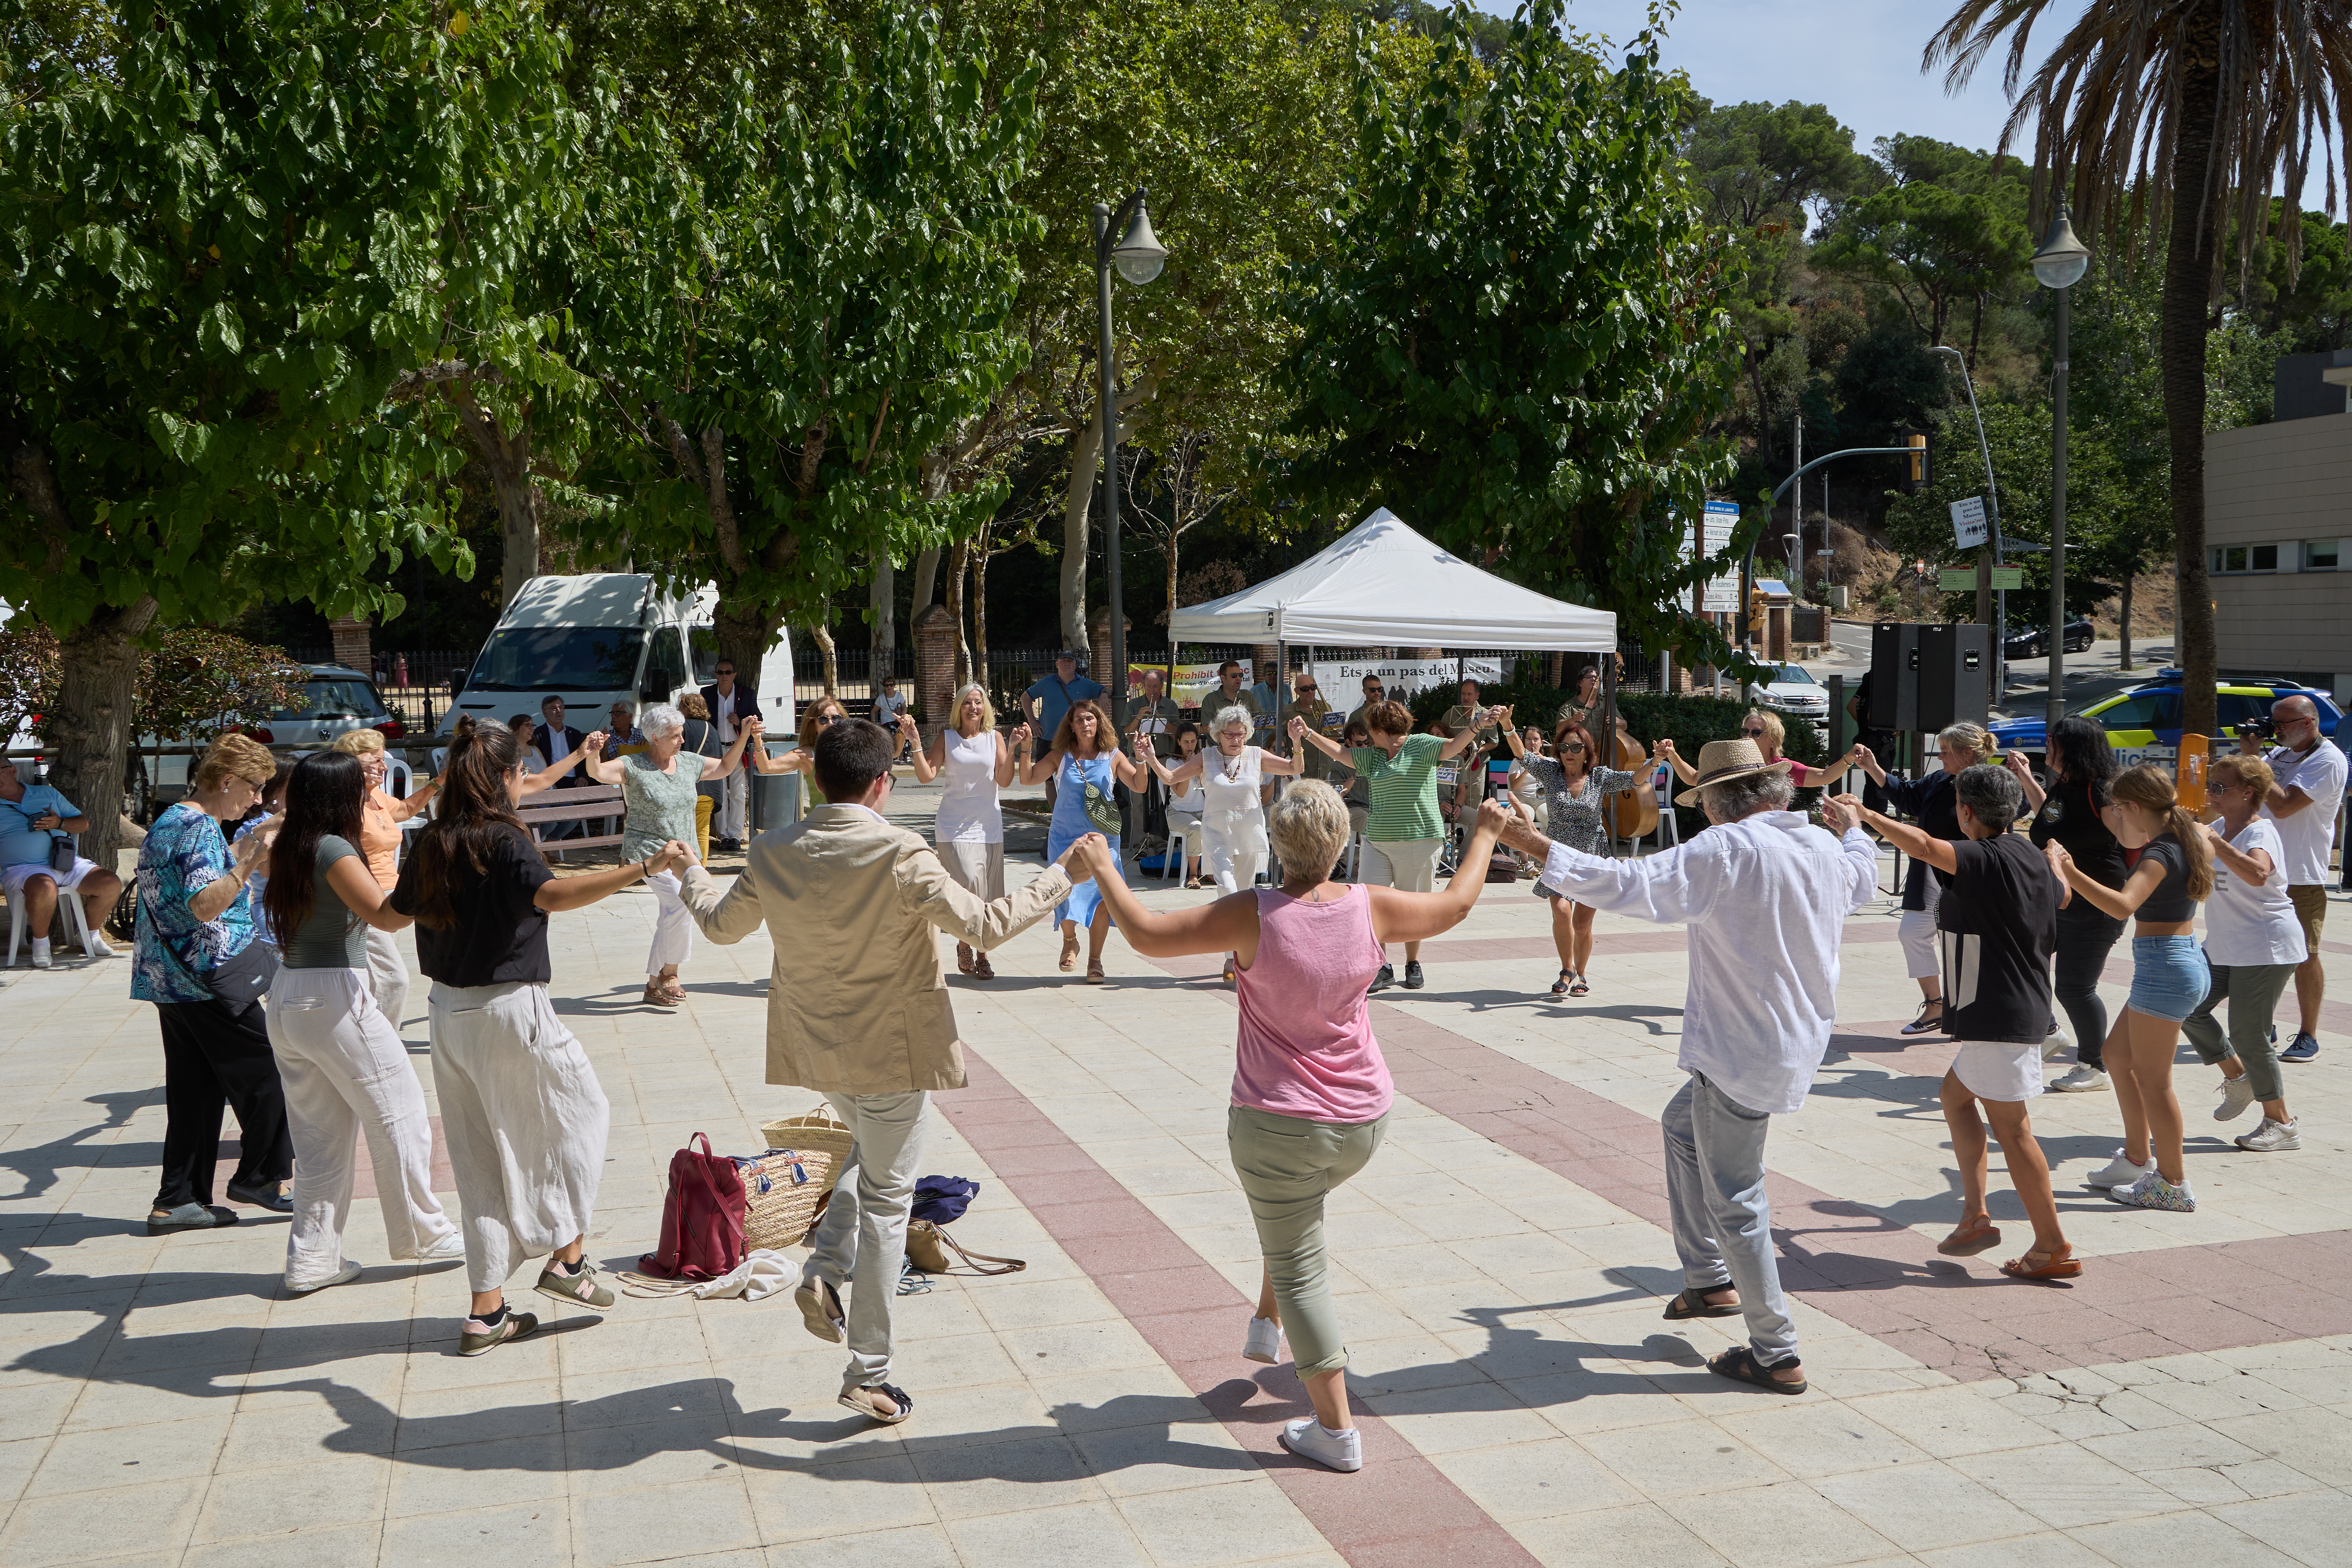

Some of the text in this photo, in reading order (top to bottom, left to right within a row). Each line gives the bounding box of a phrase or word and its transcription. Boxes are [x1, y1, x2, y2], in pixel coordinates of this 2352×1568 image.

[1959, 517, 1985, 526] Visita'ns!
[1173, 670, 1214, 679] Prohibit
[1340, 666, 1361, 677] Ets
[1377, 668, 1396, 676] un
[1399, 668, 1425, 679] pas
[1429, 664, 1447, 675] del
